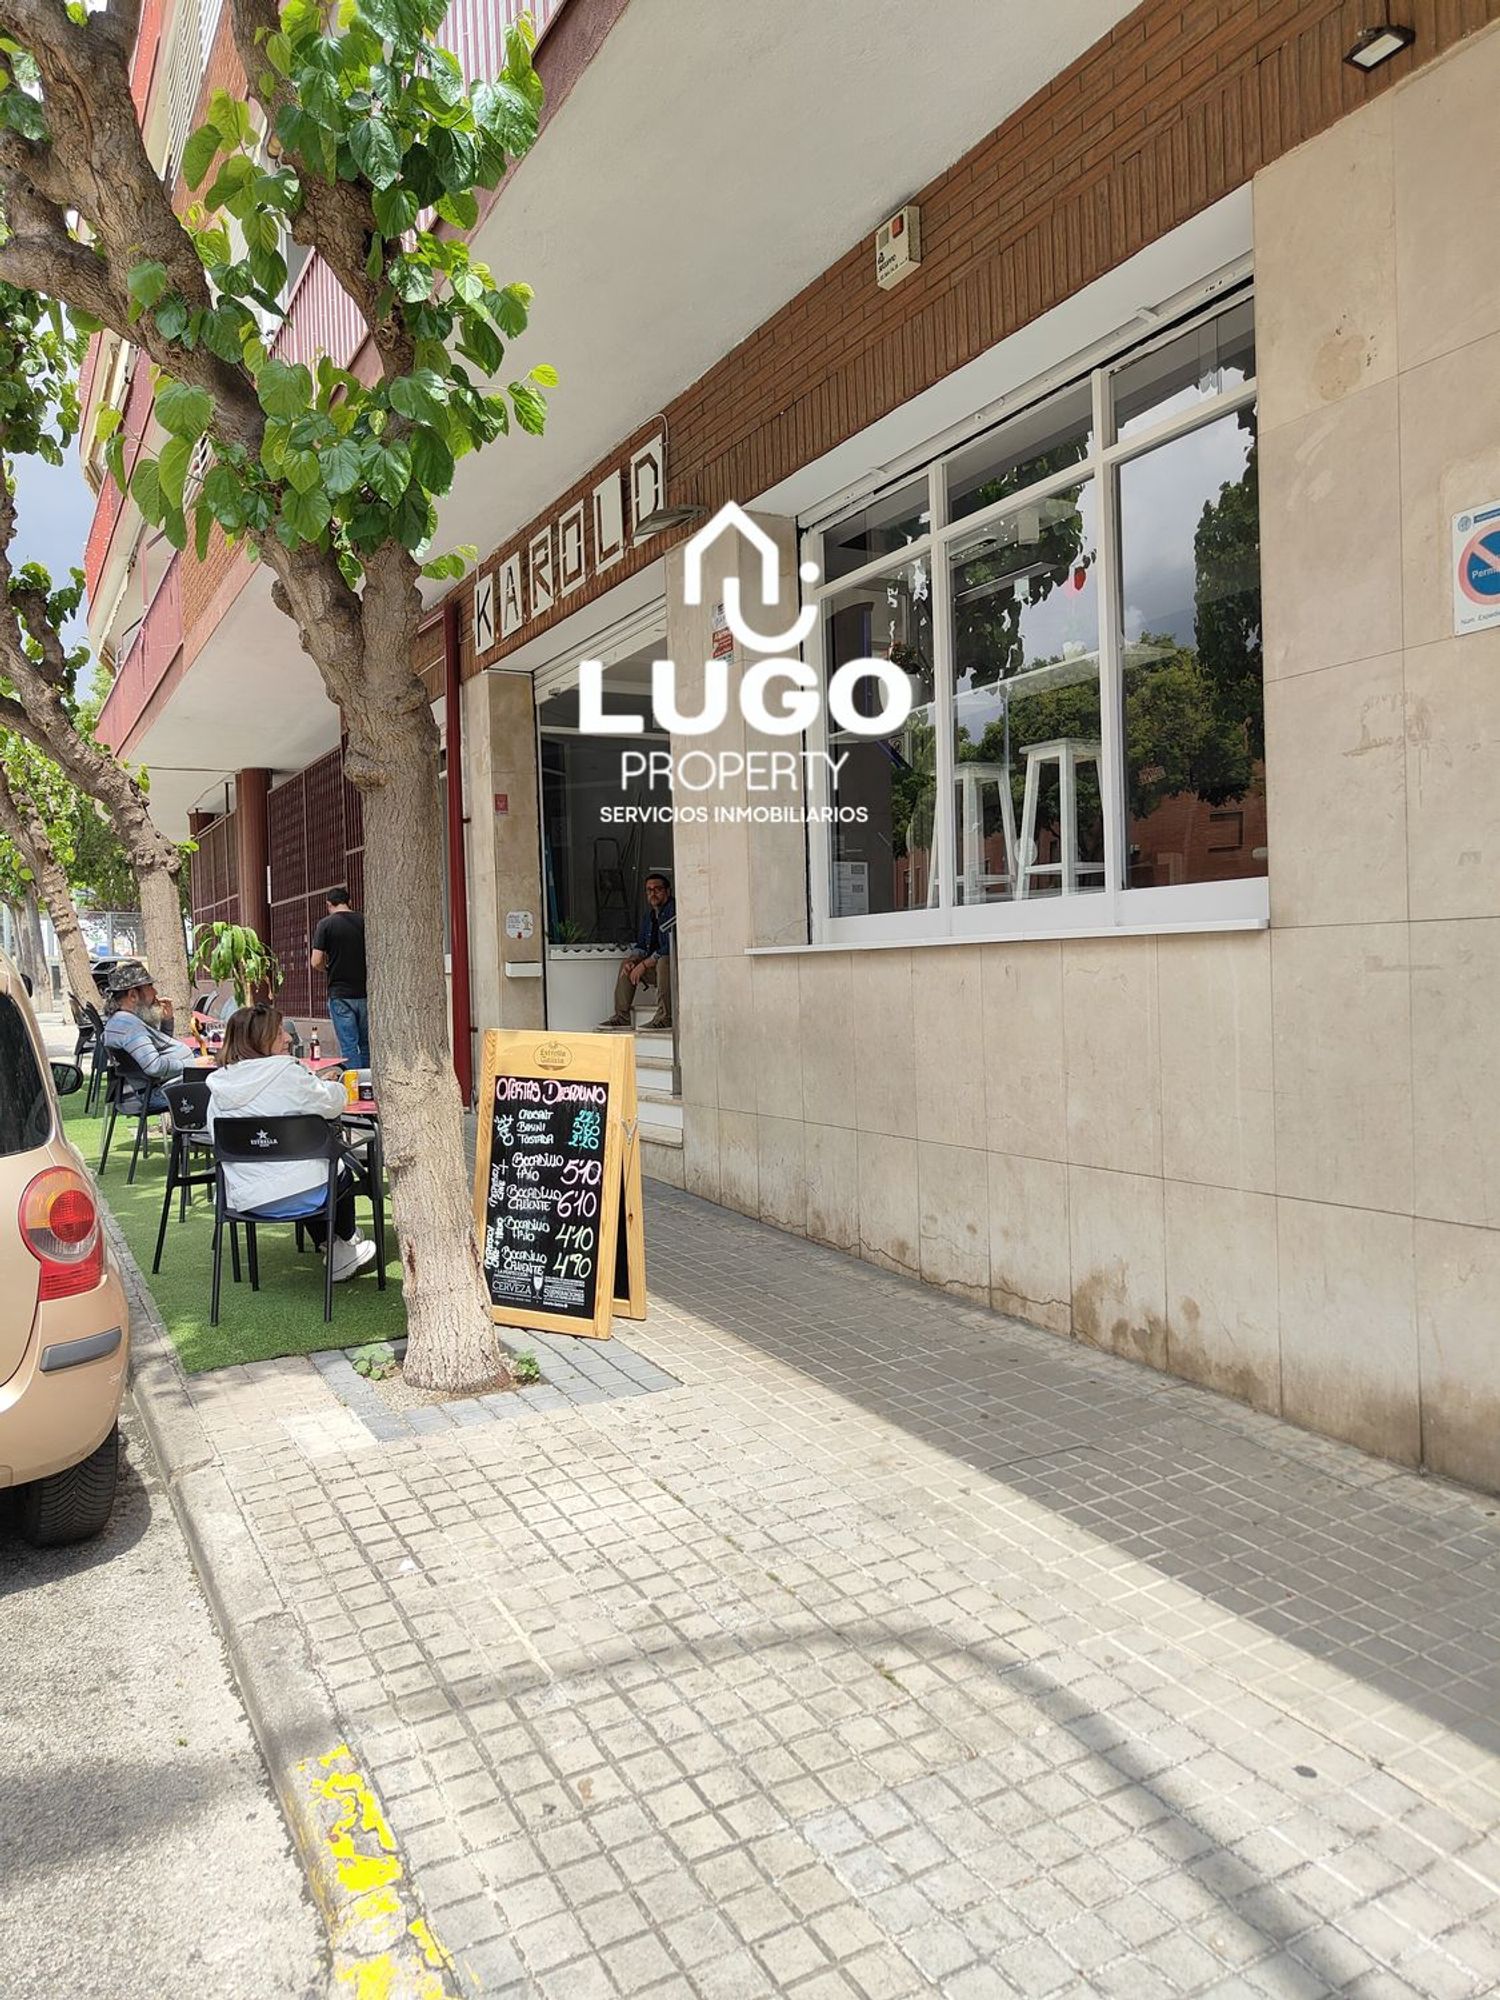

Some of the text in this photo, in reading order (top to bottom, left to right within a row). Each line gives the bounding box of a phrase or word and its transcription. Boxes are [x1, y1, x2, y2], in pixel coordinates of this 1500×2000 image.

[560, 1159, 602, 1185] 5'10
[557, 1189, 597, 1218] 6'10
[554, 1223, 594, 1251] 4'10
[552, 1252, 592, 1278] 4'90
[491, 1280, 532, 1295] CERVEZA
